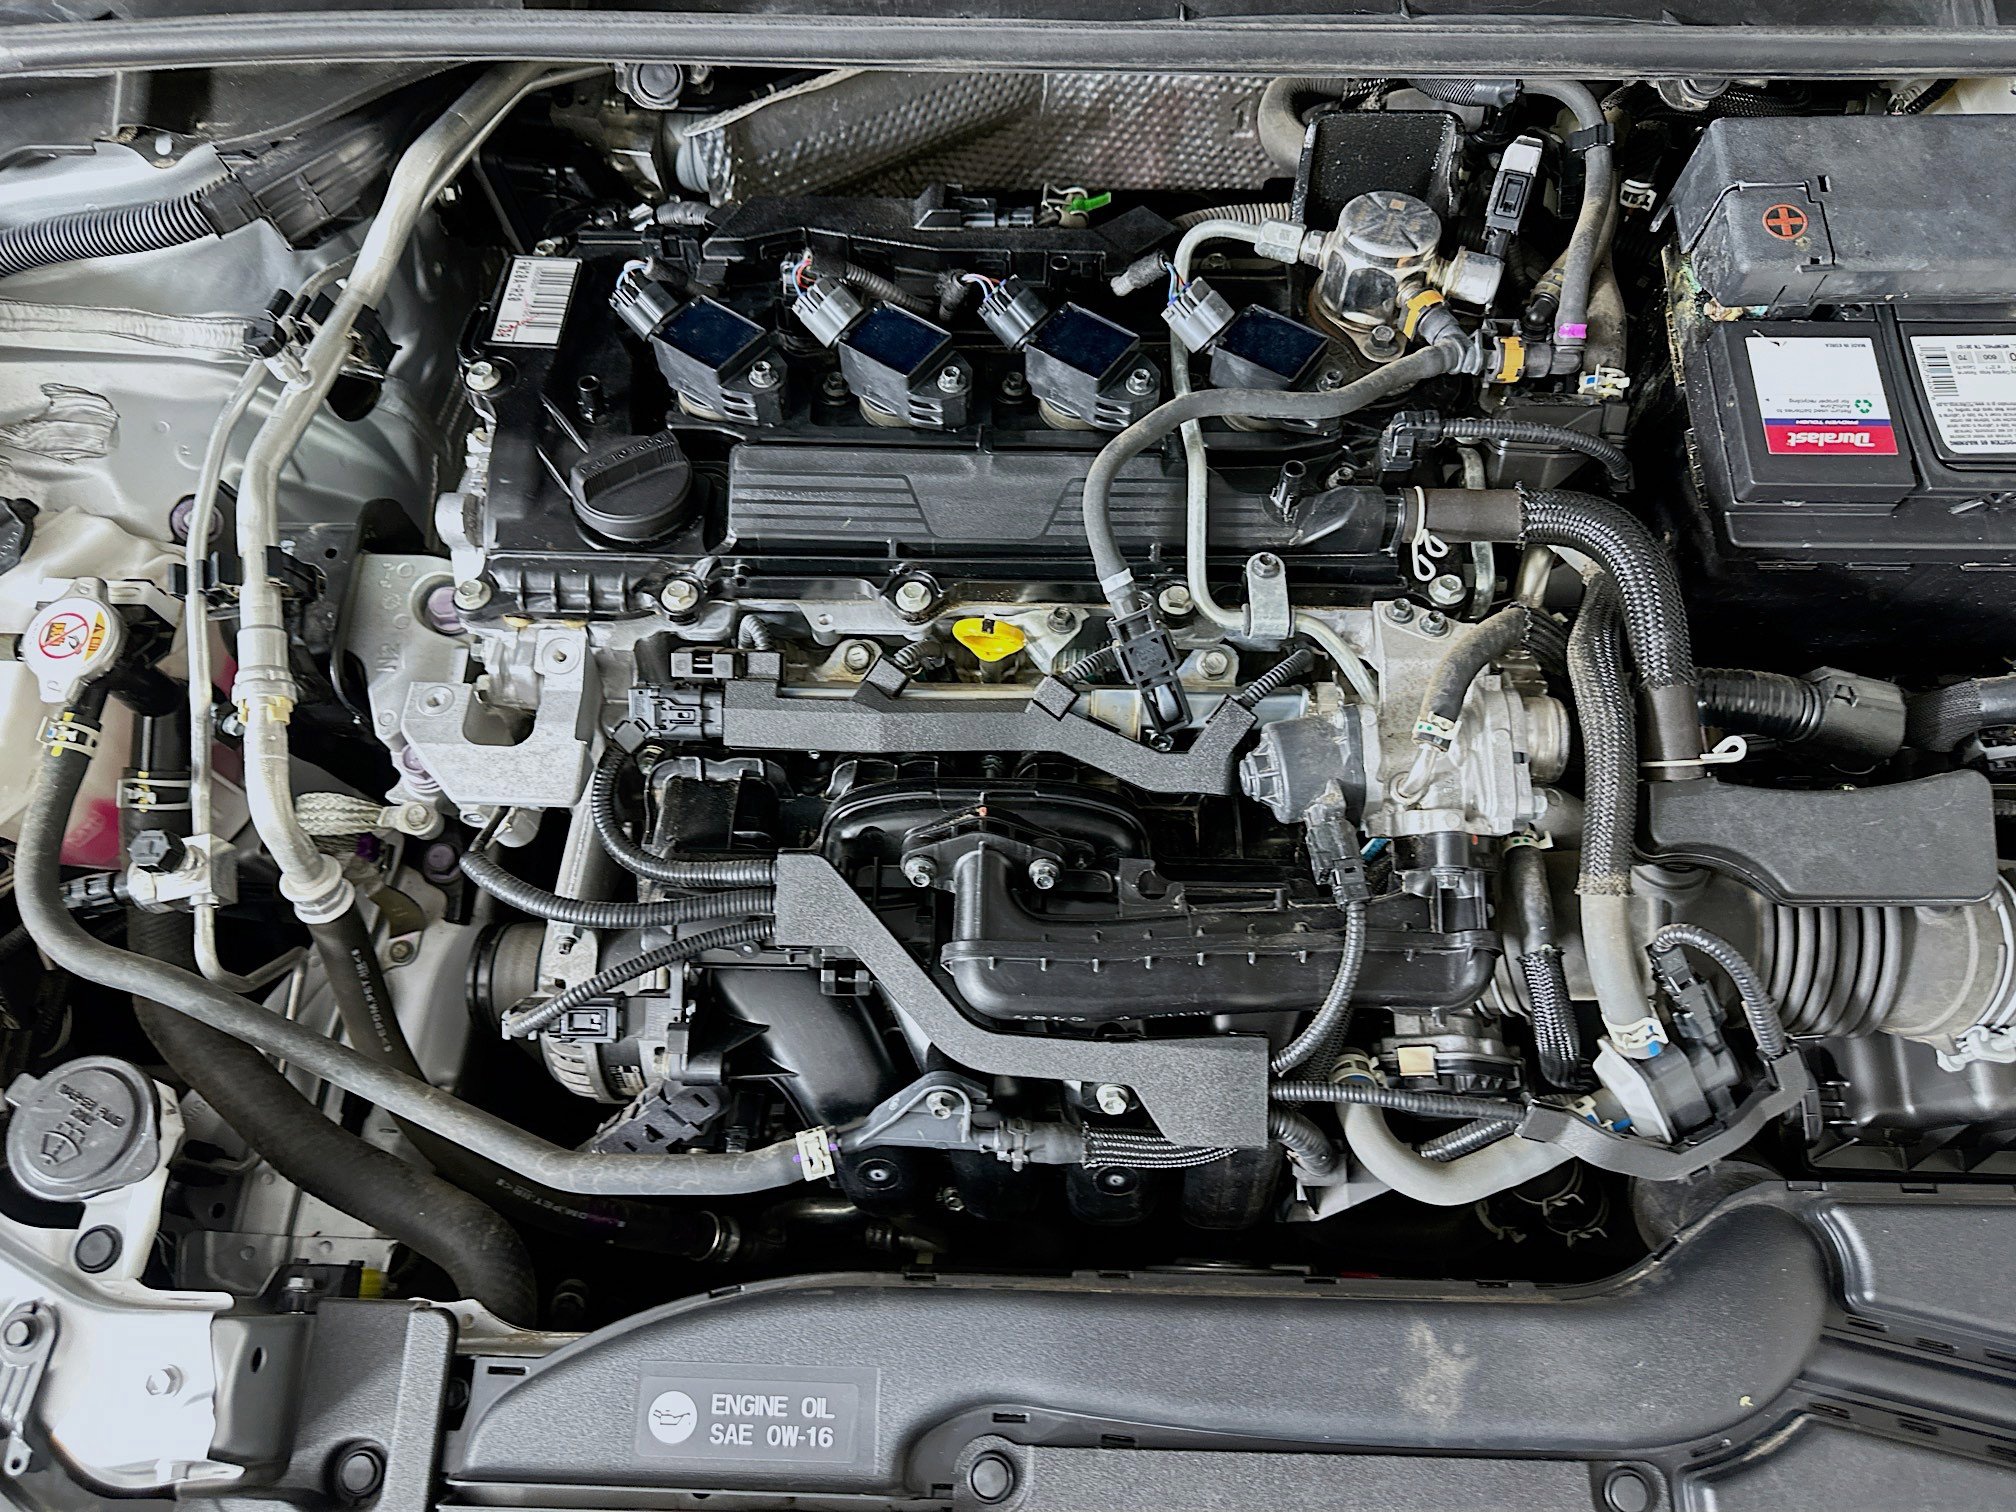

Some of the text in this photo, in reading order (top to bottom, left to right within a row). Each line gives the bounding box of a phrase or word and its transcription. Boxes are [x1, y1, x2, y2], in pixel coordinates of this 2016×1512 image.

[1787, 432, 1875, 447] Duralast
[711, 1393, 836, 1419] ENGINE OIL
[709, 1422, 834, 1448] SAE 0W-16
